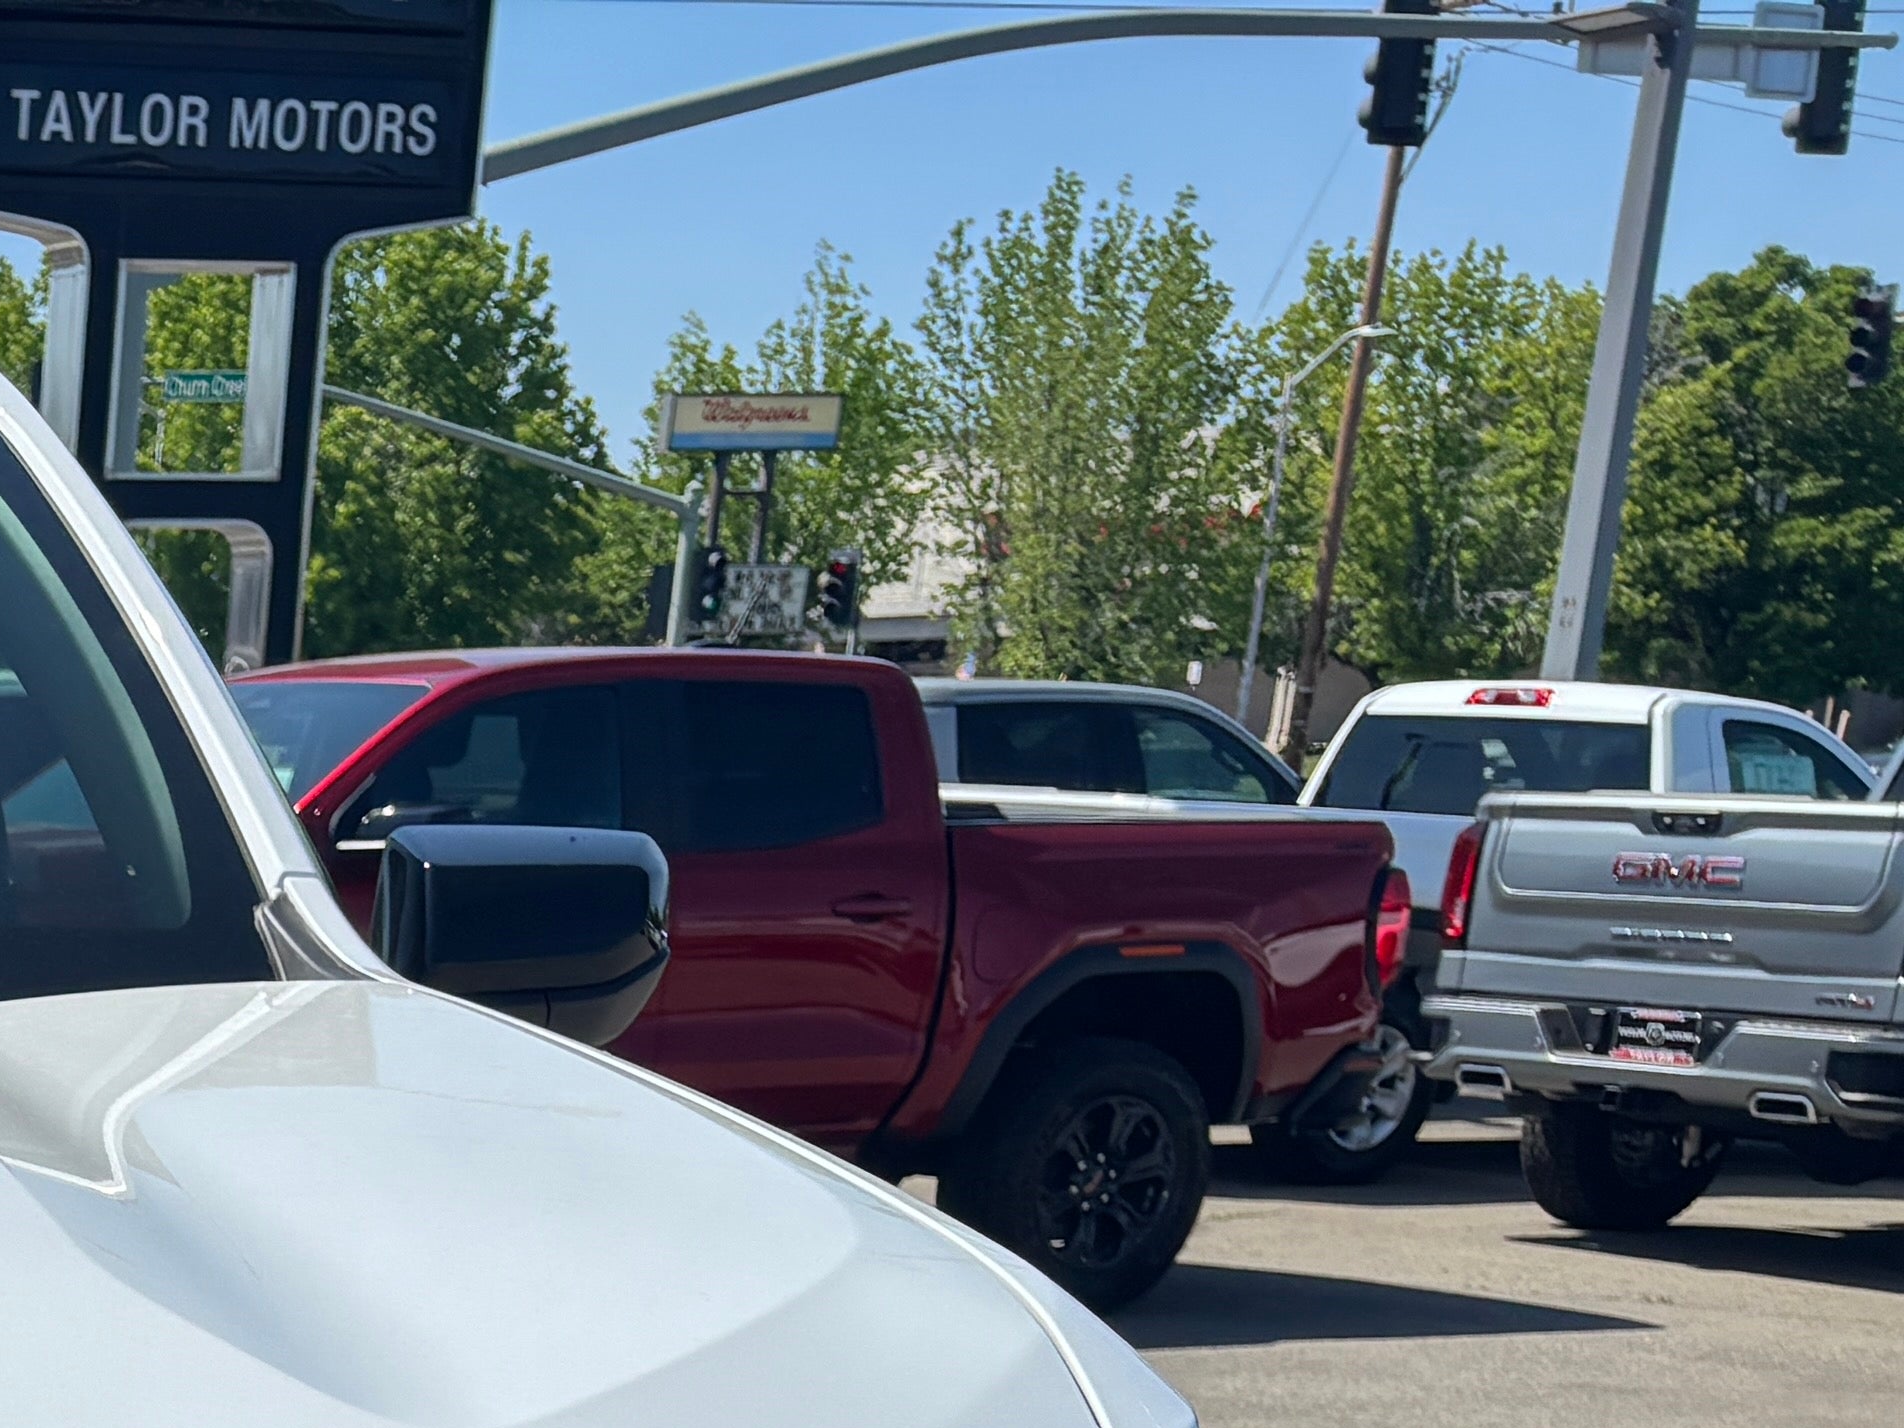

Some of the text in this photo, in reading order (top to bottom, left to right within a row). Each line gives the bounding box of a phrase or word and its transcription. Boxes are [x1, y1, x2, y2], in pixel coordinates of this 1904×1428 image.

[9, 88, 438, 157] TAYLOR MOTORS
[1612, 852, 1745, 887] GMC
